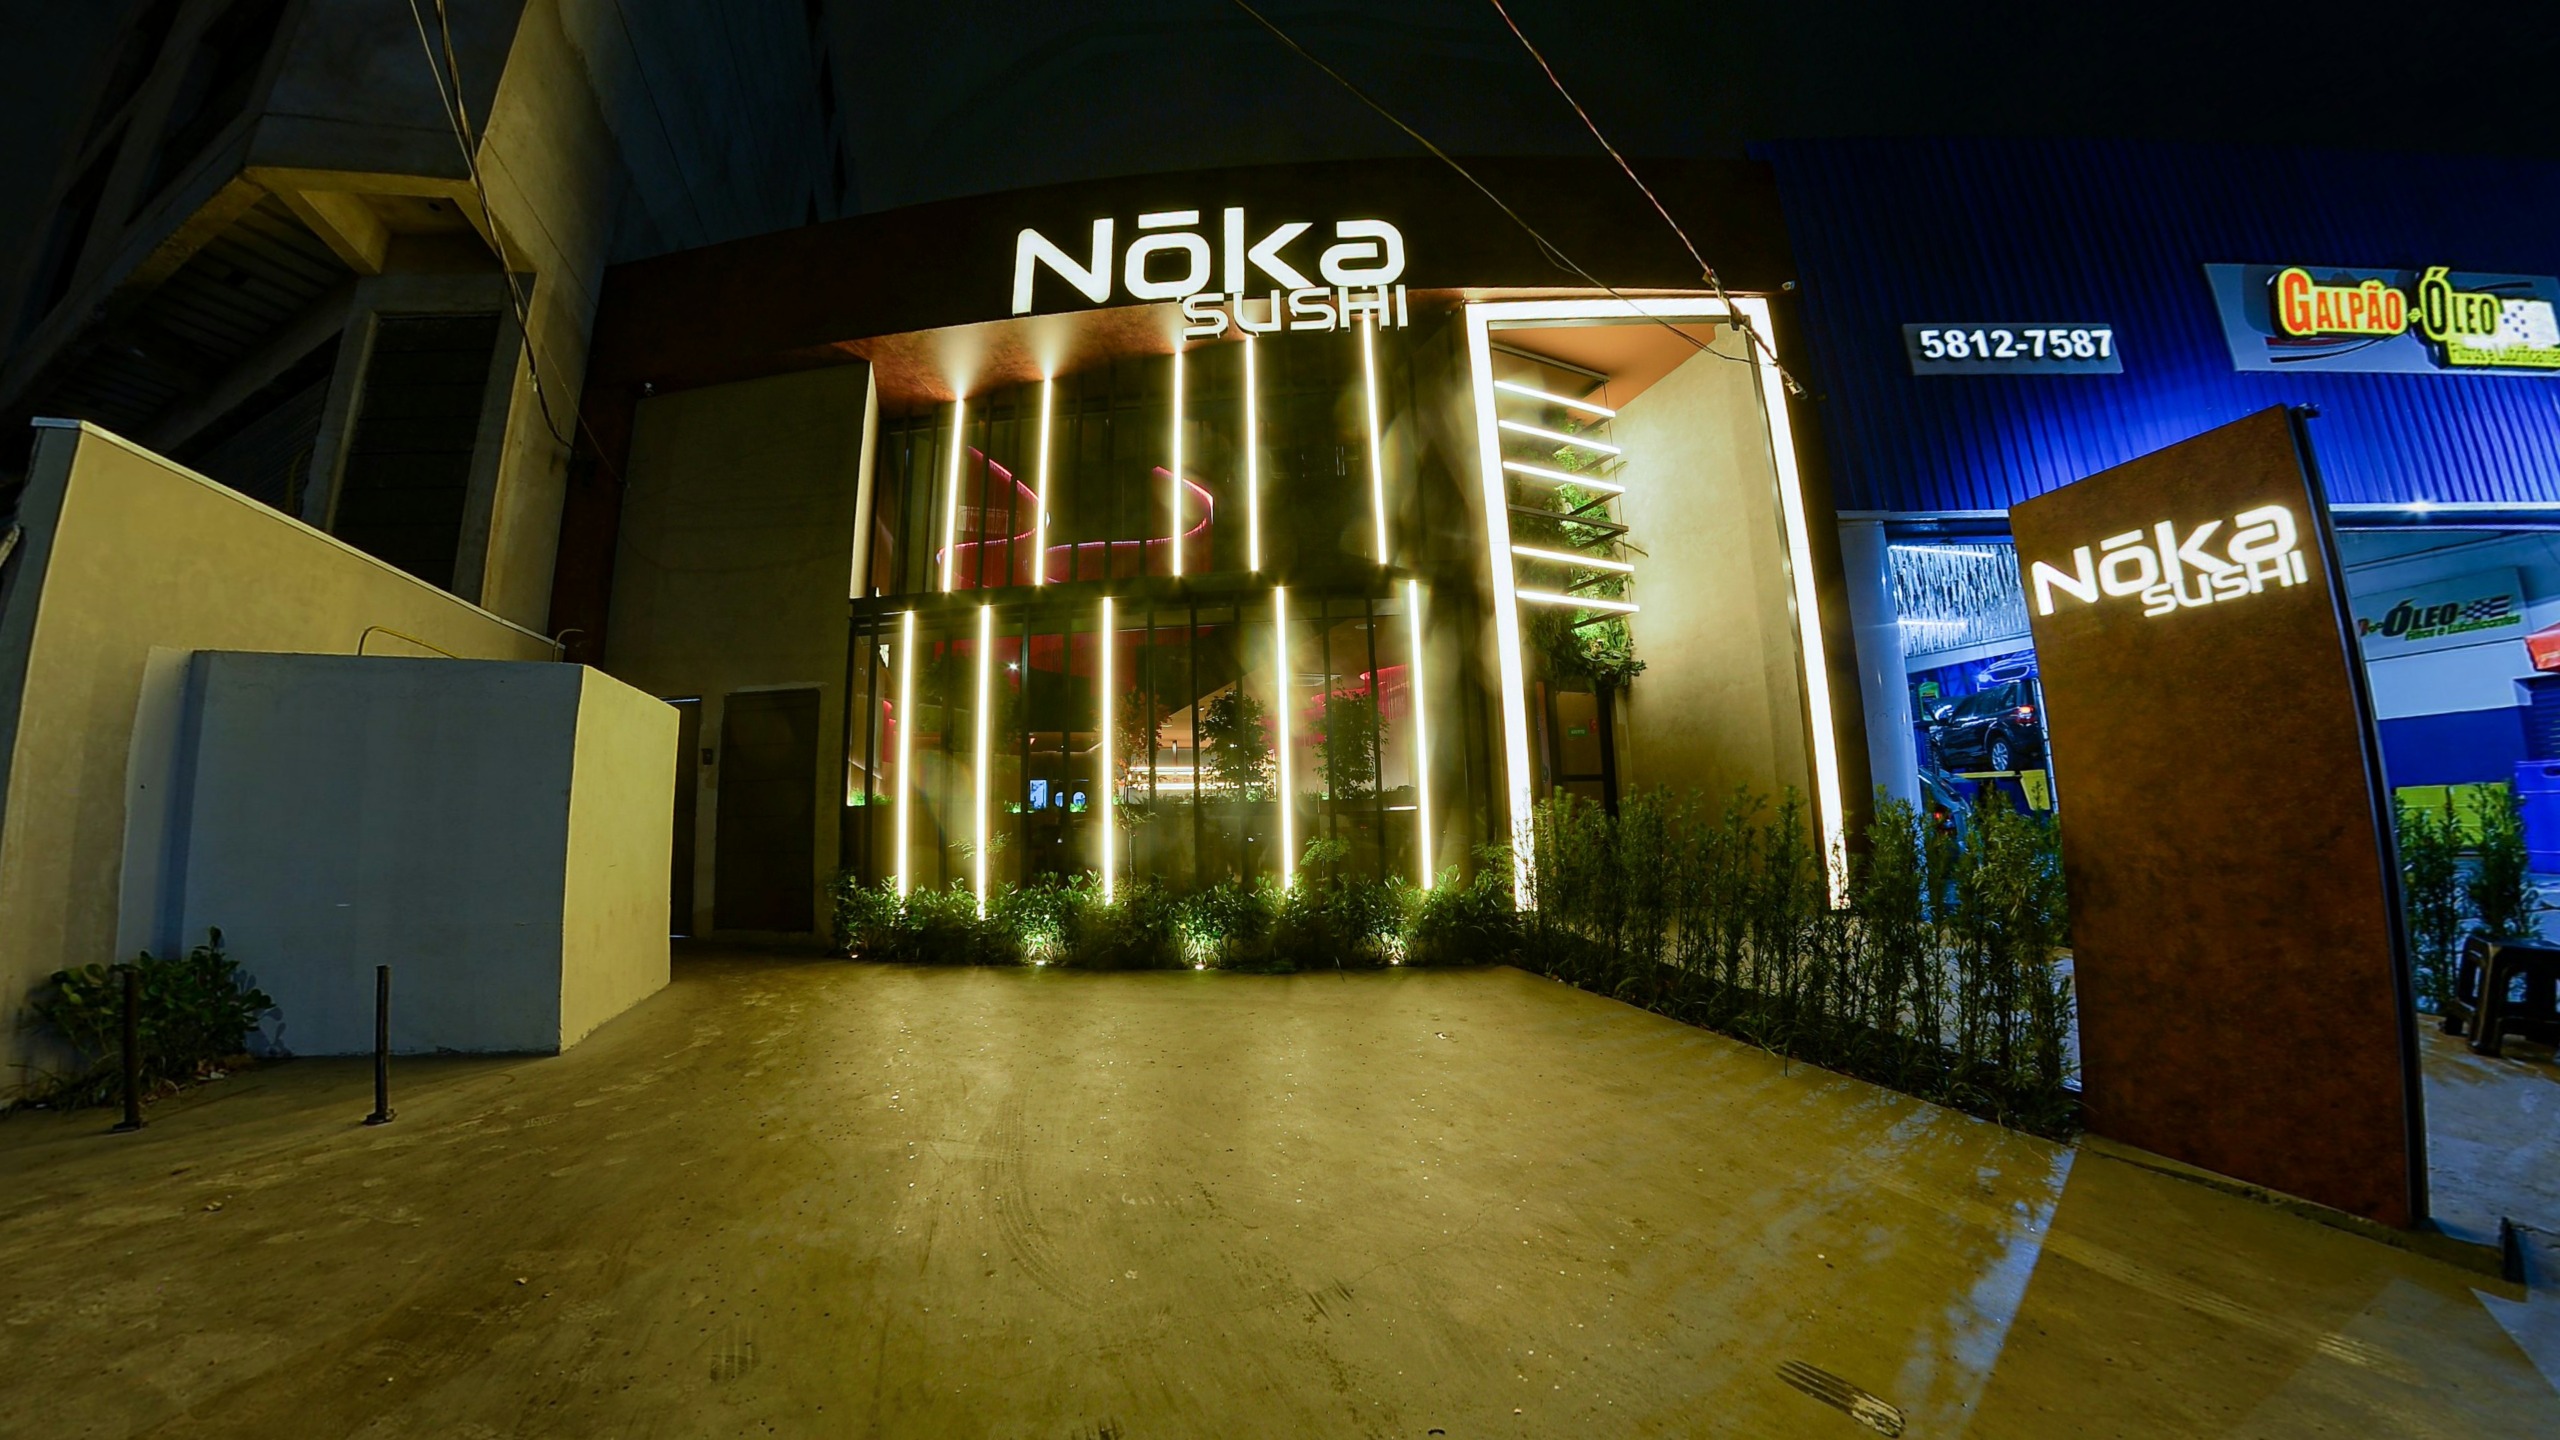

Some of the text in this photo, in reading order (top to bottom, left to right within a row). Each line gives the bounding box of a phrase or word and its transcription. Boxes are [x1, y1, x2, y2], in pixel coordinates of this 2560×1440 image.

[2421, 267, 2499, 339] ÓLEO
[1919, 329, 2112, 359] 5812-7587
[2381, 597, 2459, 638] ÓLEO
